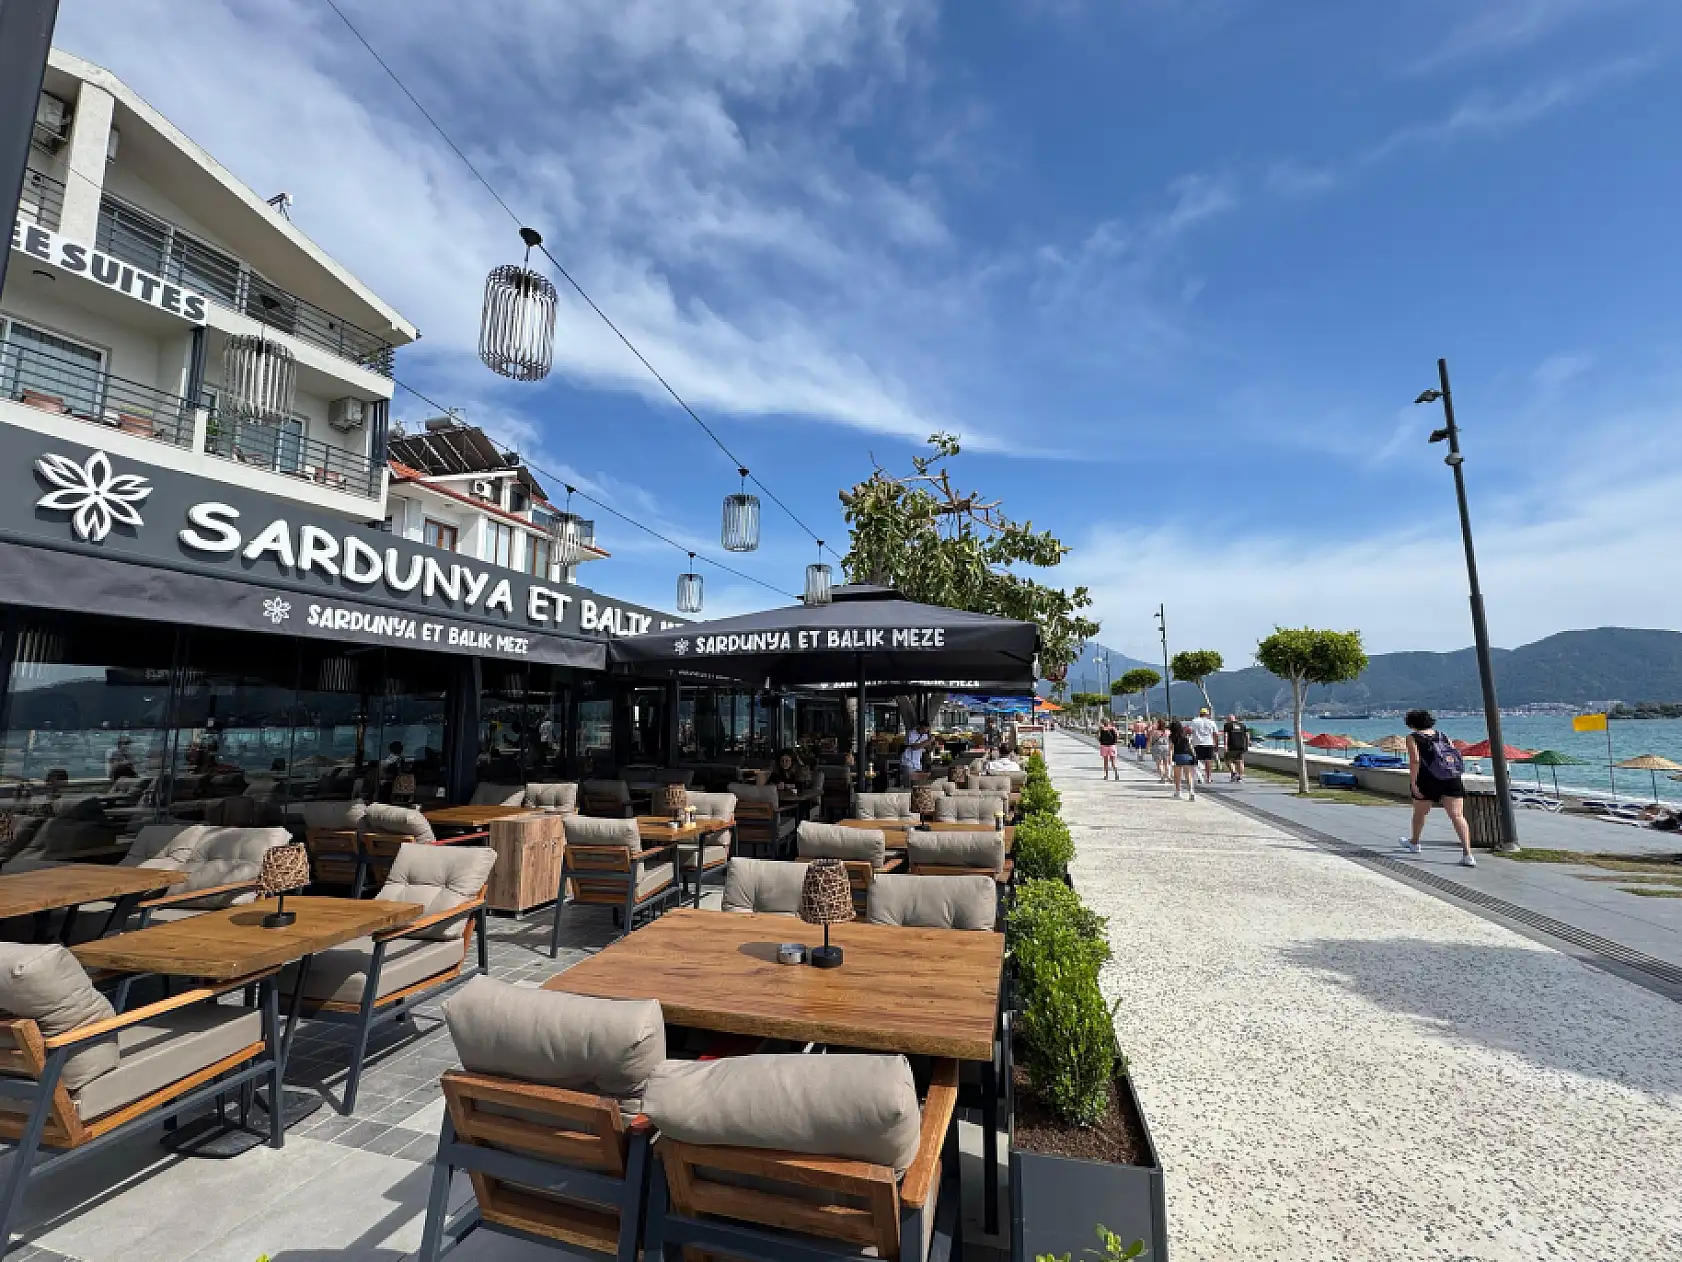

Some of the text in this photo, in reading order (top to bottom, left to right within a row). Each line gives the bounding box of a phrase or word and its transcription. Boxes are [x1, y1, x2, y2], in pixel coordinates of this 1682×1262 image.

[60, 243, 206, 321] SUITES
[178, 501, 653, 635] SARDUNYA ET BALIK
[307, 604, 529, 654] SARDUNYA ET BALIK MEZE
[695, 628, 945, 653] SARDUNYA ET BALIK MEZE
